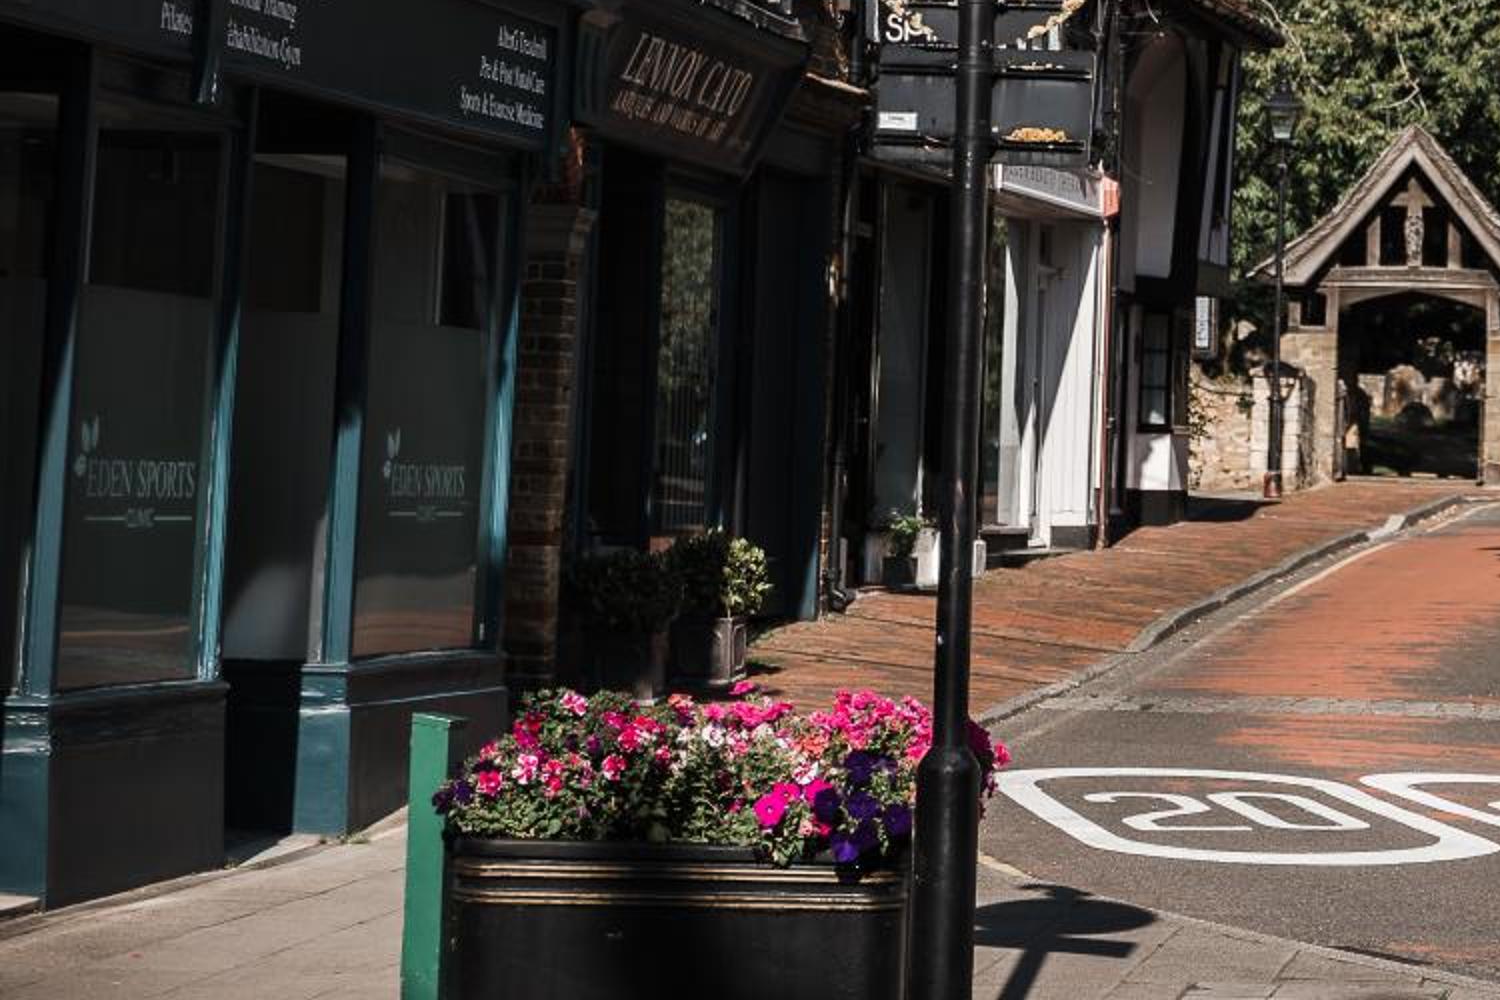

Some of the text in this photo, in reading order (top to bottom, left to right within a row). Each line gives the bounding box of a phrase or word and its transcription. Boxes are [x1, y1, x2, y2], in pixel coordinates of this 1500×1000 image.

[161, 1, 193, 35] Pilates
[227, 18, 301, 70] ehabilitation Gym
[621, 33, 753, 117] LENNOX CATO
[86, 458, 197, 500] EDEN SPORTS
[391, 463, 465, 499] EDEN SPORTS
[1084, 790, 1372, 832] 20
